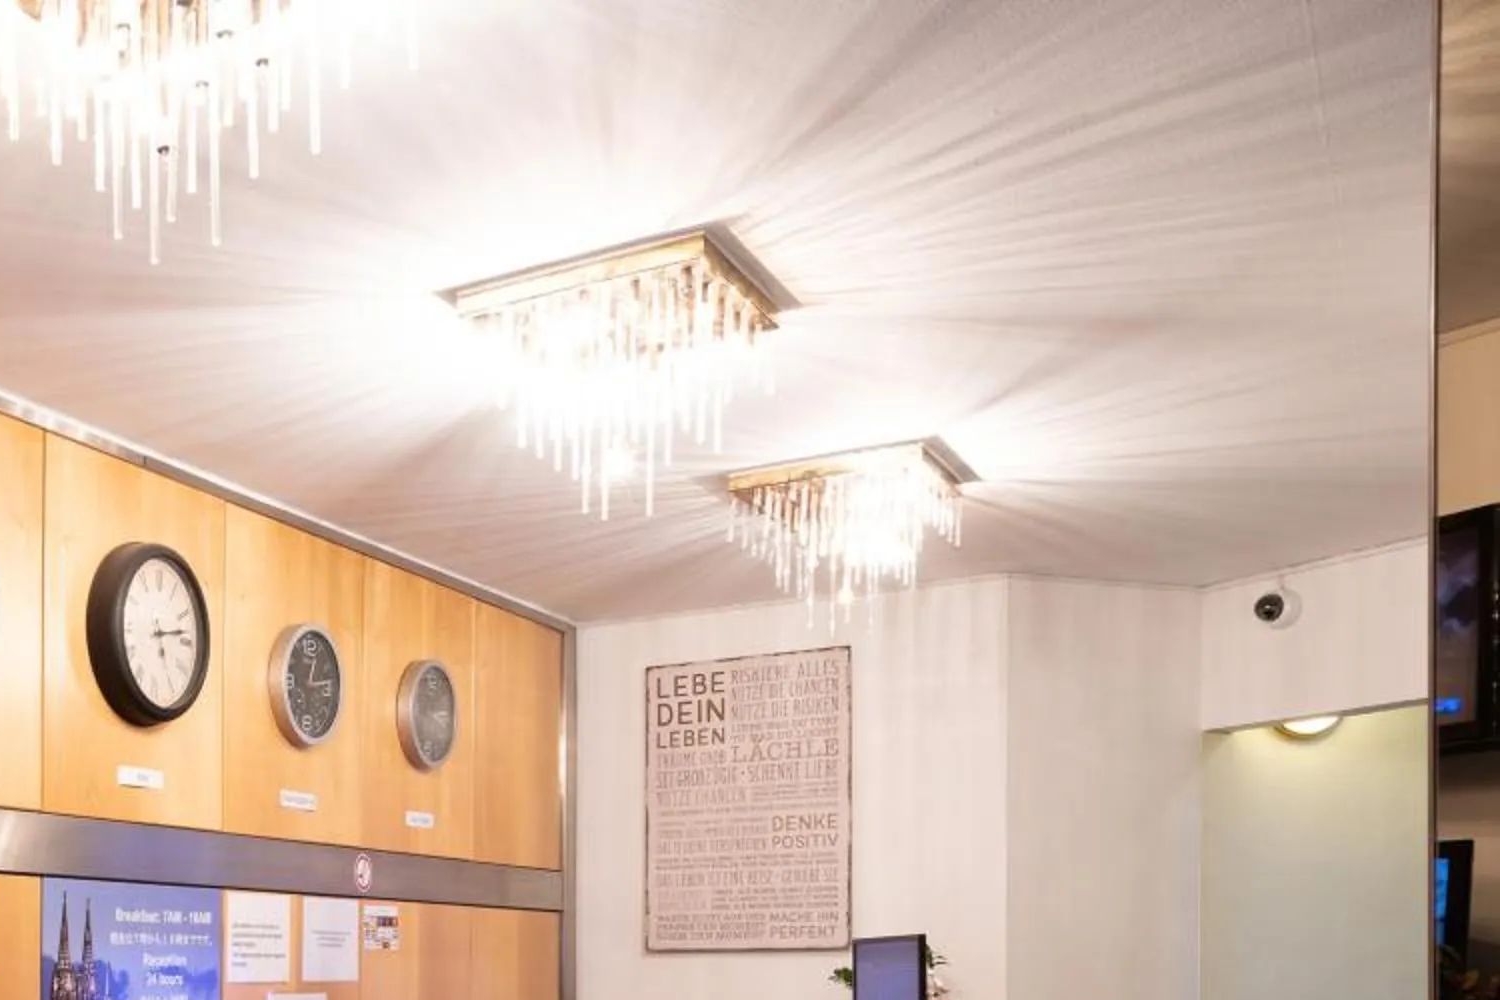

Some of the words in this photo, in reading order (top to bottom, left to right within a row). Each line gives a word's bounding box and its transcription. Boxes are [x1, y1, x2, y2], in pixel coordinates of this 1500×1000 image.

[656, 671, 725, 699] LEBE
[657, 697, 725, 727] DEIN
[656, 727, 725, 749] LEBEN
[731, 737, 839, 763] LÄCHLE
[771, 812, 839, 833] DENKE
[771, 833, 839, 850] POSITIV
[770, 912, 813, 923] MACHE
